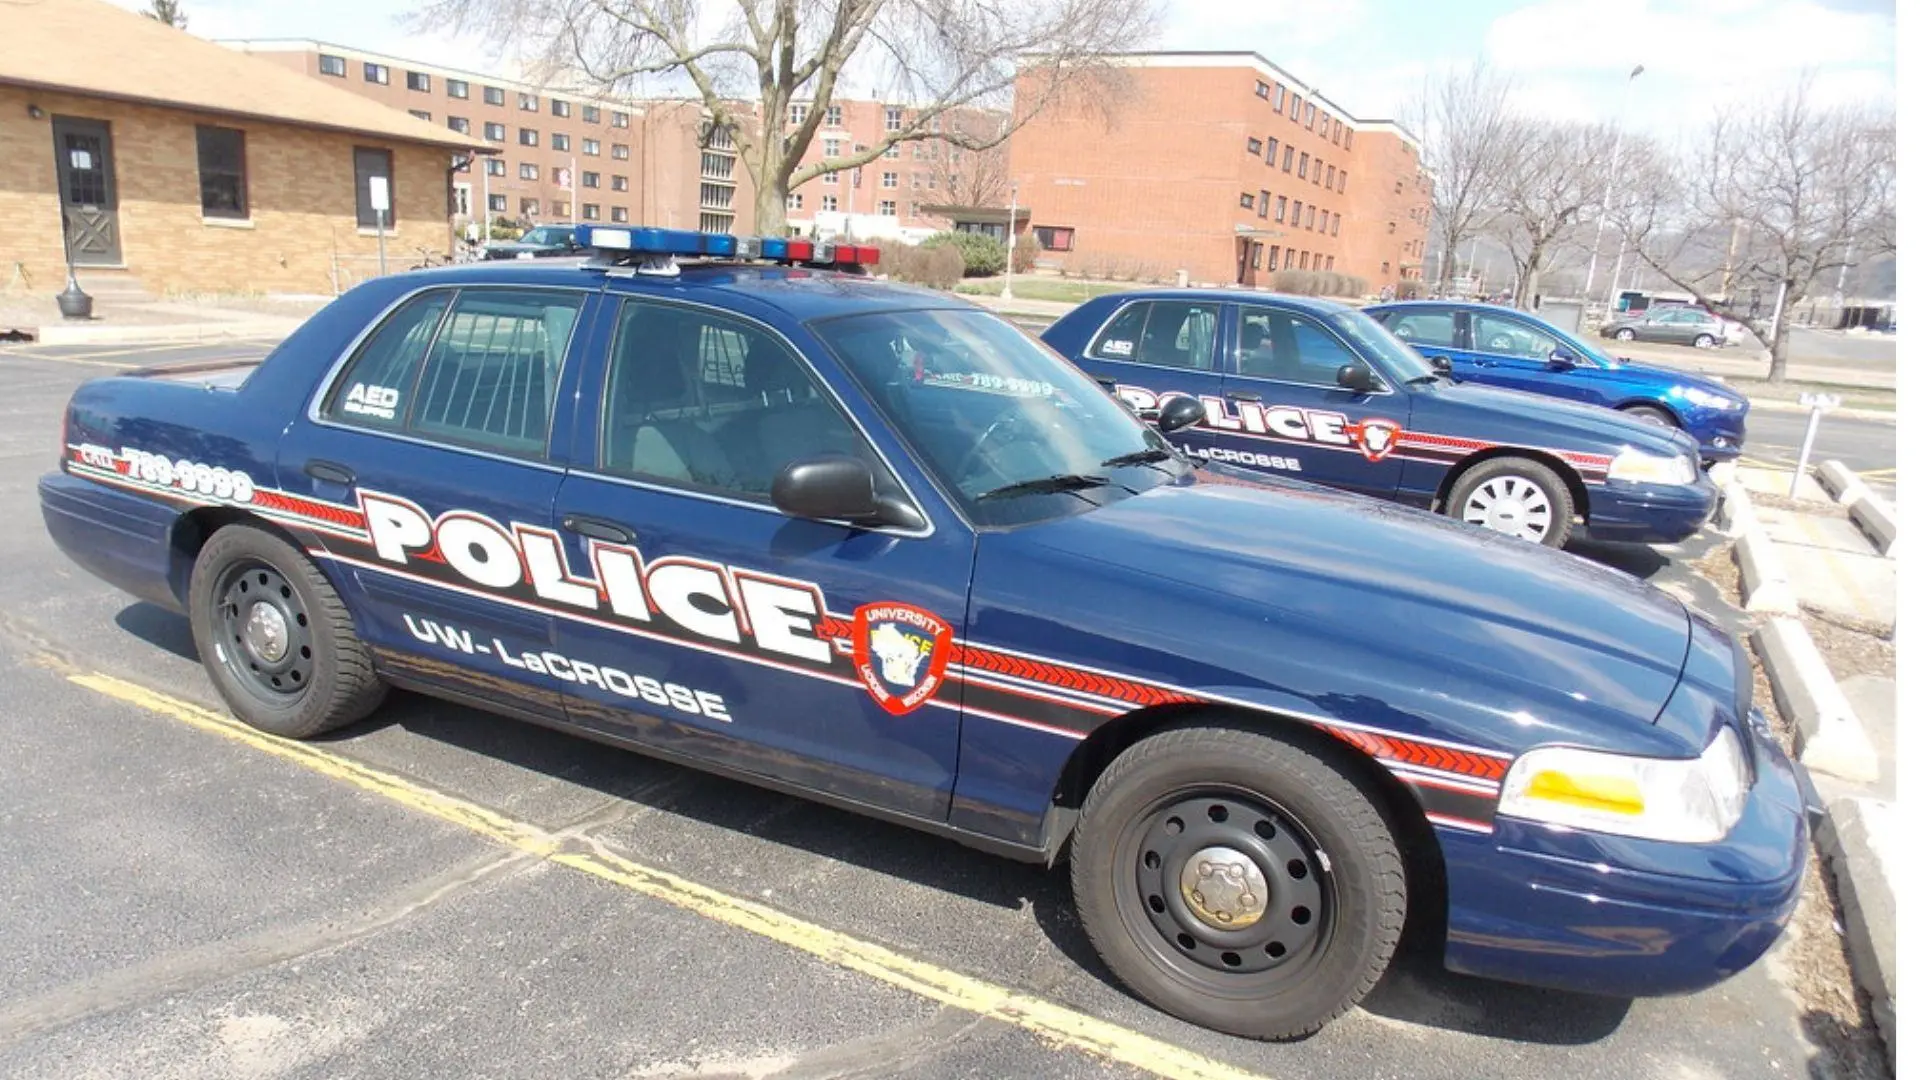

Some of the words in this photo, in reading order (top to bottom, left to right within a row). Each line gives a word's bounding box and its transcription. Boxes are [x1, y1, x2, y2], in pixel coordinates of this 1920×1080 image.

[346, 382, 399, 408] AED
[1114, 384, 1350, 444] PLICE
[120, 447, 254, 502] 789-9999
[357, 487, 832, 665] POLICE
[865, 608, 945, 636] UNIVERSITY
[496, 637, 733, 723] LaCROSSE
